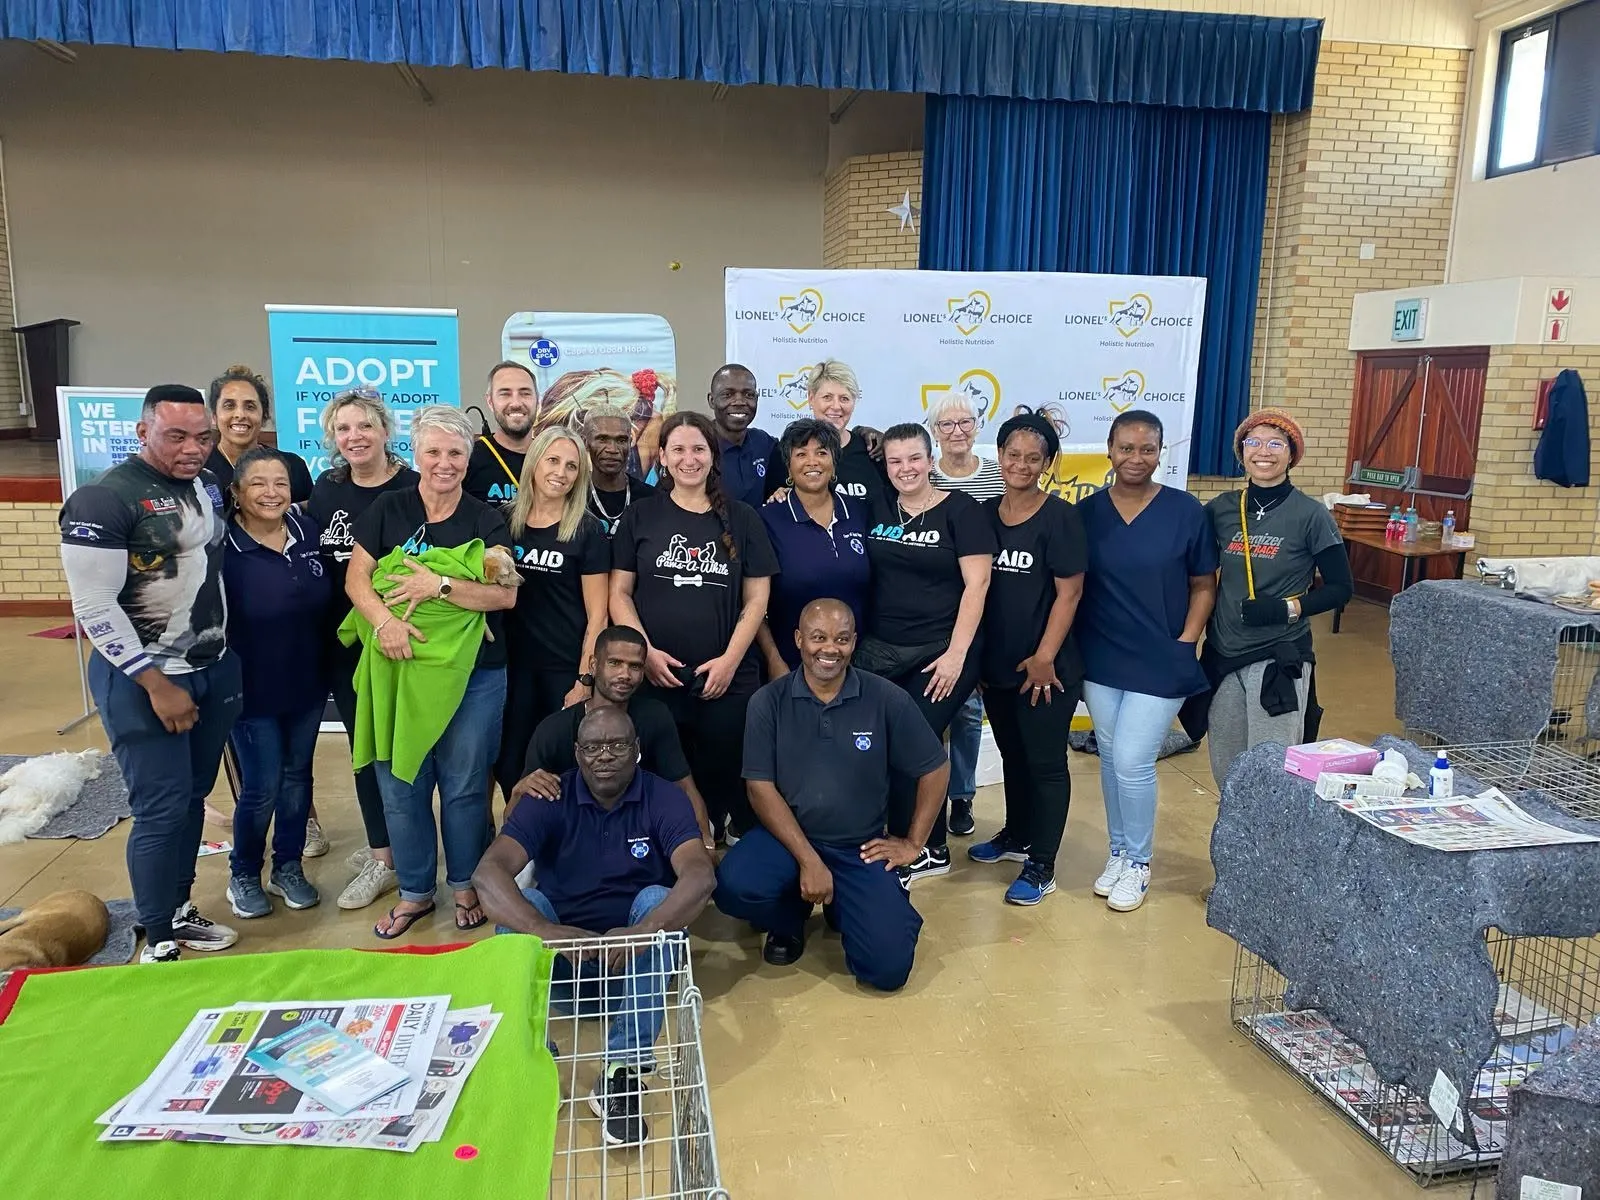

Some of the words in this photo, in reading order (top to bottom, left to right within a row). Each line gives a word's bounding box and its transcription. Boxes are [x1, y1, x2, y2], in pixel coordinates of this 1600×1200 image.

[822, 312, 866, 322] CHOICE
[990, 314, 1033, 324] CHOICE
[1150, 317, 1193, 327] CHOICE
[1395, 309, 1418, 330] EXIT
[772, 336, 798, 344] Holistic
[564, 347, 587, 356] Cape
[600, 346, 623, 354] Good
[625, 345, 647, 353] Hope
[295, 357, 438, 388] ADOPT
[296, 391, 308, 401] IF
[391, 393, 440, 404] ADOPT
[1143, 392, 1186, 402] CHOICE
[78, 402, 116, 418] WE
[81, 420, 137, 436] STEP
[83, 437, 107, 454] IN
[300, 440, 311, 450] IF
[1254, 544, 1280, 555] RACE
[405, 1002, 426, 1030] DAILY
